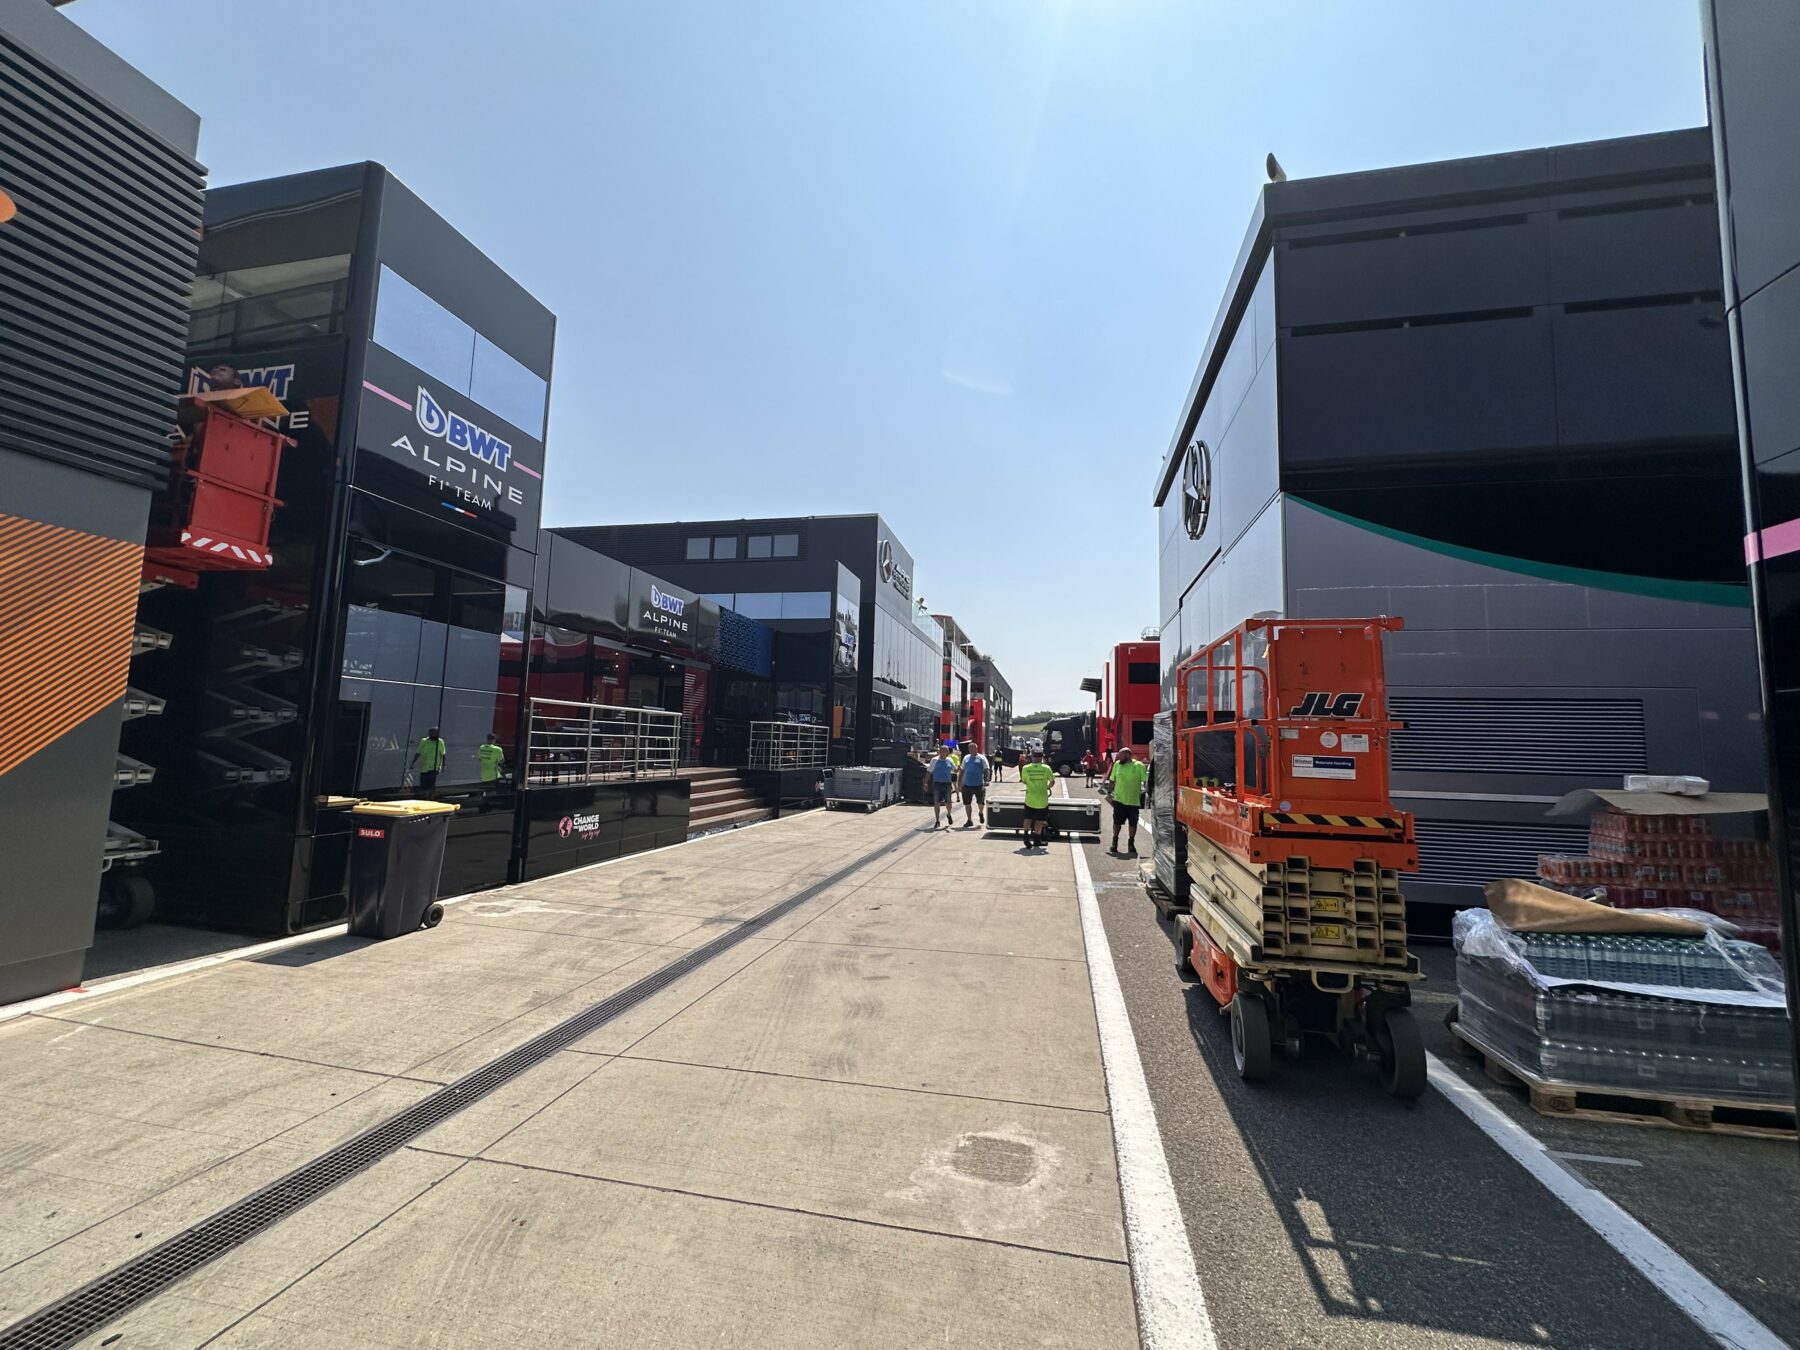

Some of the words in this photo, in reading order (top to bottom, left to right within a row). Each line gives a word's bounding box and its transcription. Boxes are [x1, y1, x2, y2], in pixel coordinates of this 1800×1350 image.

[446, 410, 512, 472] BWT
[391, 435, 523, 505] ALPINE
[455, 485, 492, 511] TEAM
[660, 592, 684, 616] BWT
[643, 610, 689, 632] ALPINE
[663, 629, 677, 639] TEAM
[1290, 692, 1365, 717] JLG
[573, 814, 600, 825] CHANGE
[578, 822, 599, 832] WORLD
[360, 829, 380, 837] SULO
